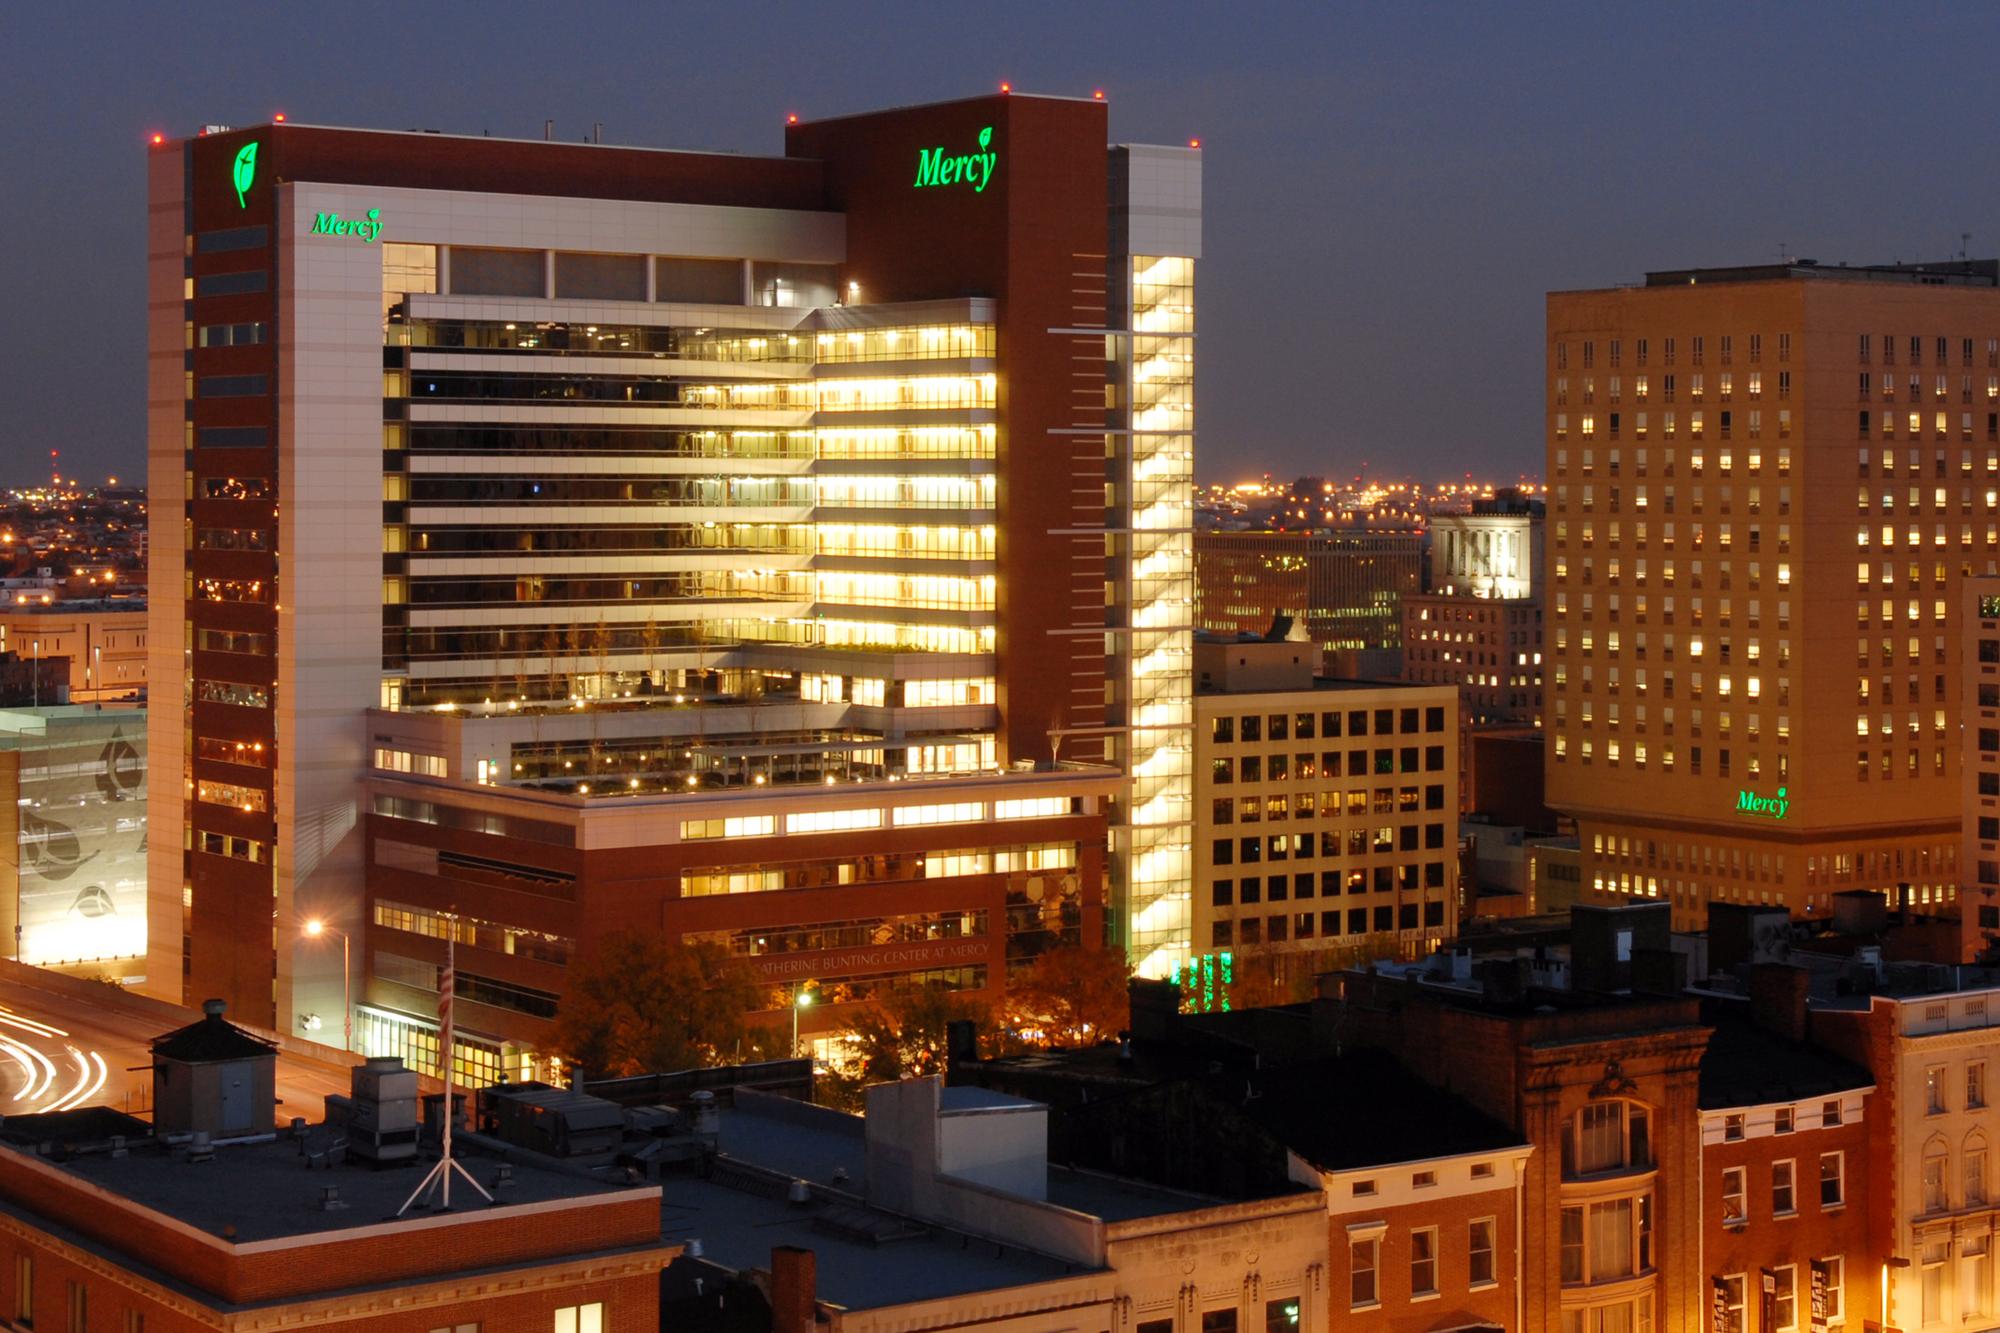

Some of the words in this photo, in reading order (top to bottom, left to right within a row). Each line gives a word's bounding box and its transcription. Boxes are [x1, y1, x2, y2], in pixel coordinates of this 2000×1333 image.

[913, 146, 996, 193] Mercy
[311, 212, 384, 243] Mercy
[1736, 790, 1790, 819] Mercy
[756, 958, 818, 977] ATHERINE
[823, 953, 880, 969] BUNTING
[883, 948, 929, 964] CENTER
[933, 946, 945, 958] AT
[950, 943, 990, 957] MERCY
